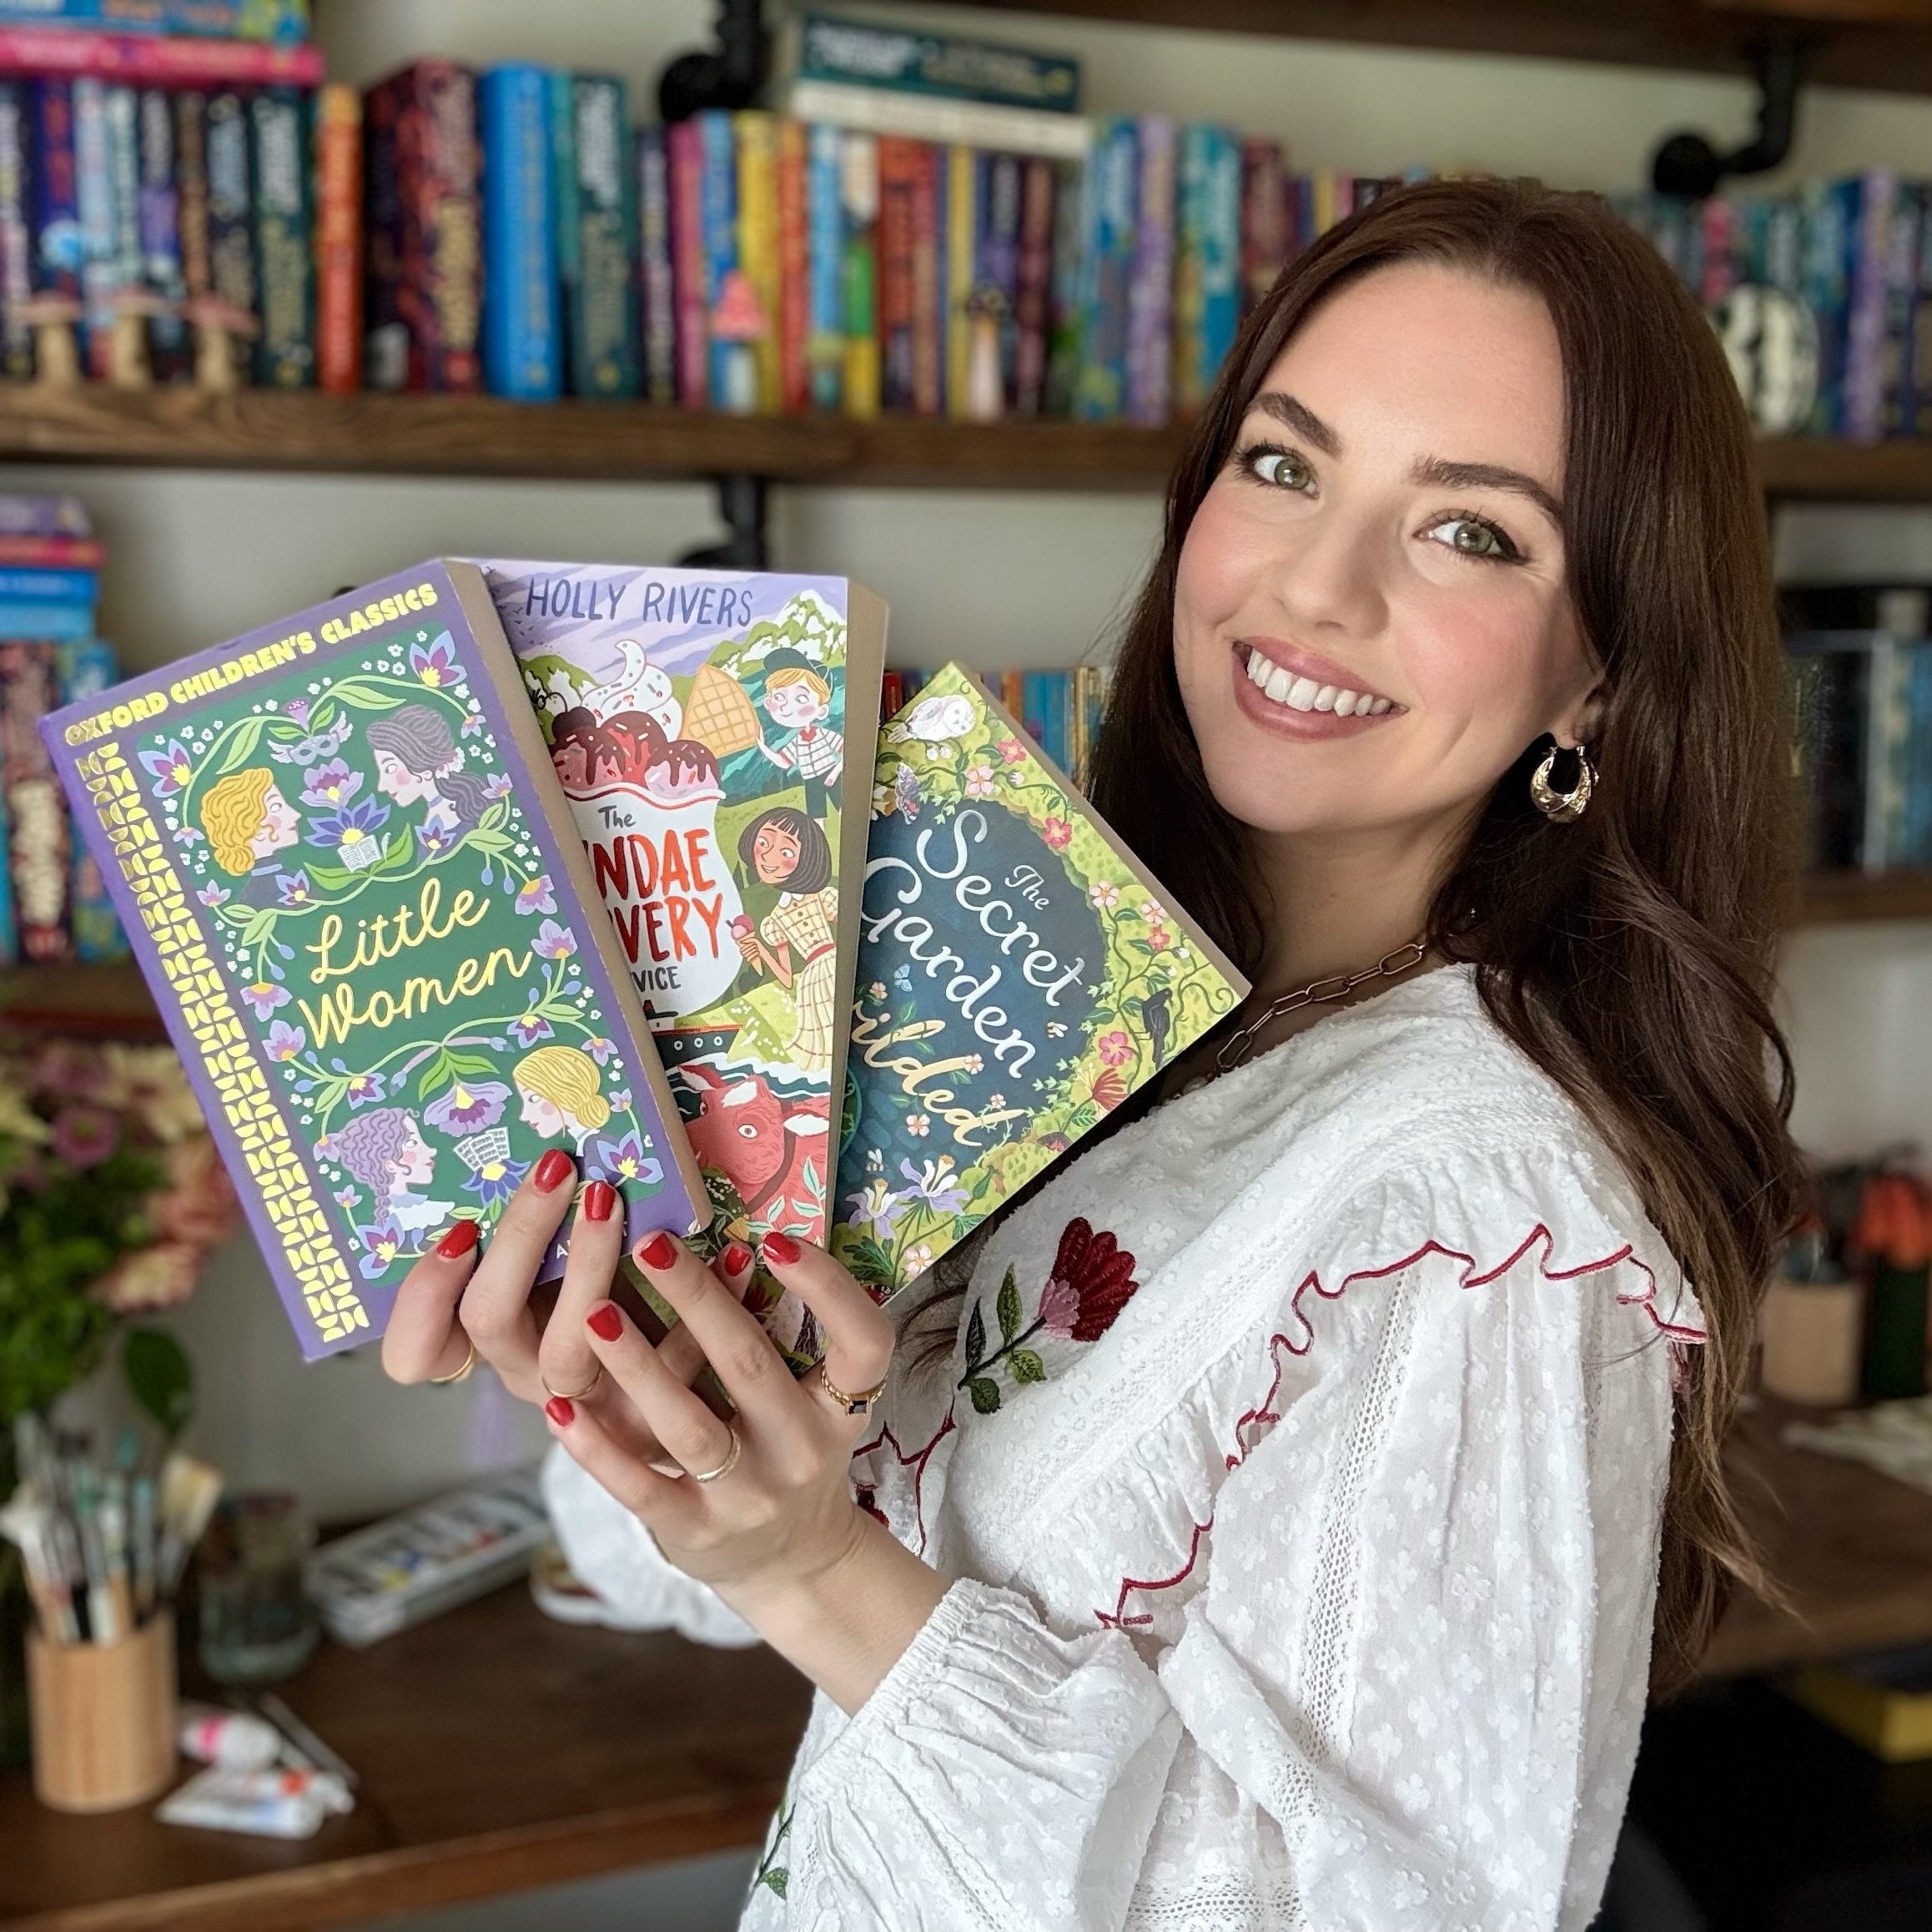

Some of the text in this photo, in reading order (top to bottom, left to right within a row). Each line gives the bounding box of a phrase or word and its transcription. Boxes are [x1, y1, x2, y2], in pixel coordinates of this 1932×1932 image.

[526, 577, 752, 627] HOLLY RIVERS
[64, 583, 439, 747] OXFORD CHILDREN'S CLASSICS
[598, 805, 636, 829] The
[582, 828, 717, 900] NDAE
[1004, 864, 1049, 910] The
[305, 878, 491, 984] Little
[607, 893, 723, 963] VERY
[917, 809, 1084, 1007] Secret
[298, 948, 533, 1049] Women
[630, 965, 682, 993] VICE
[861, 857, 1036, 1079] Garden
